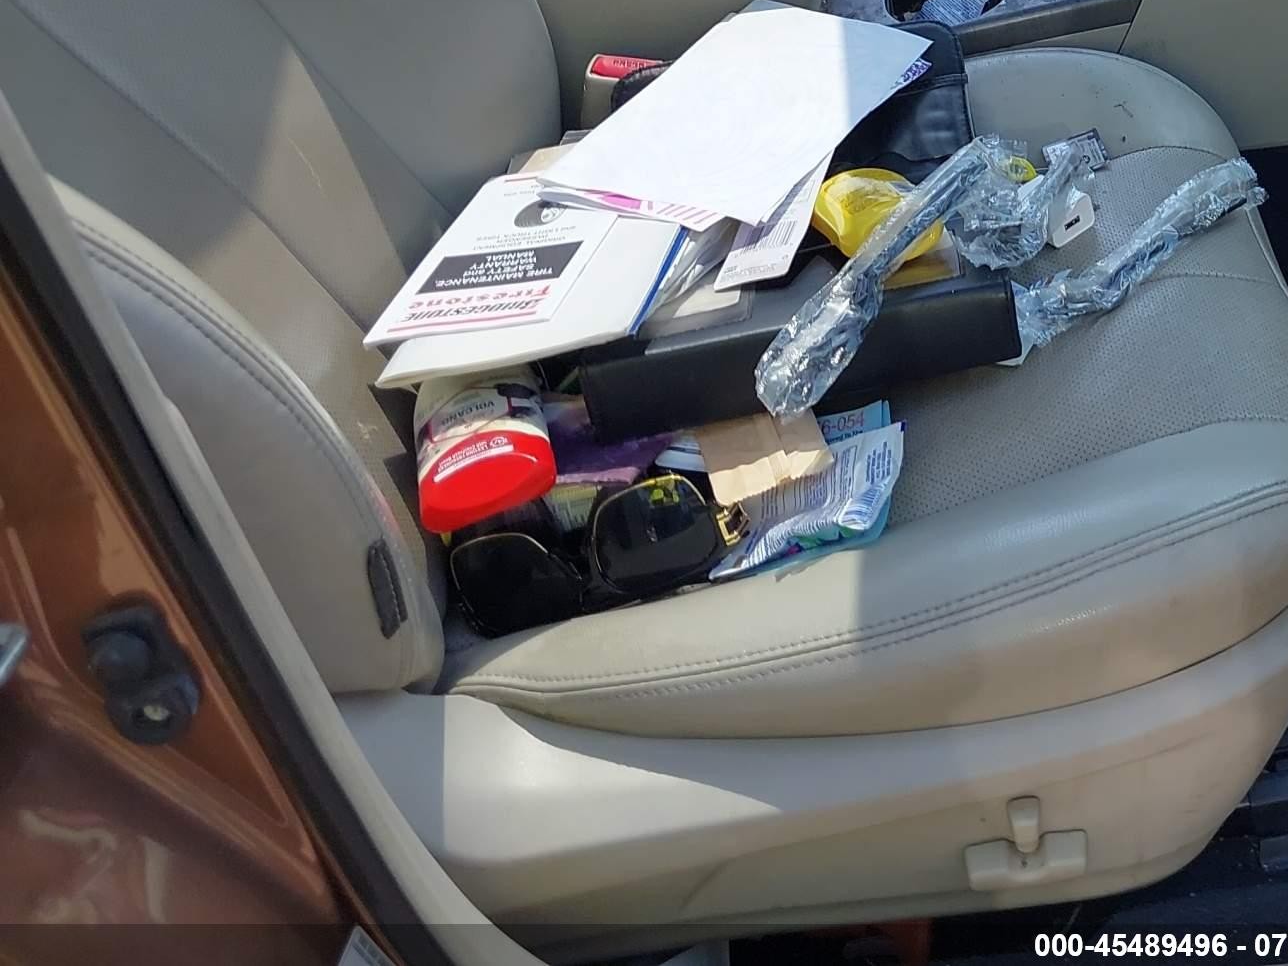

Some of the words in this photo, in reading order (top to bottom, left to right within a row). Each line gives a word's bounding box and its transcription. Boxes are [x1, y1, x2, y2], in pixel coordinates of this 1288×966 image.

[486, 250, 535, 262] MANUAL
[470, 258, 537, 271] WARRANTY
[487, 264, 535, 276] SAFETY
[528, 267, 553, 277] TIRE
[408, 285, 551, 310] Firestone
[402, 298, 544, 322] BRIDGESTONE
[820, 411, 864, 434] 6-054
